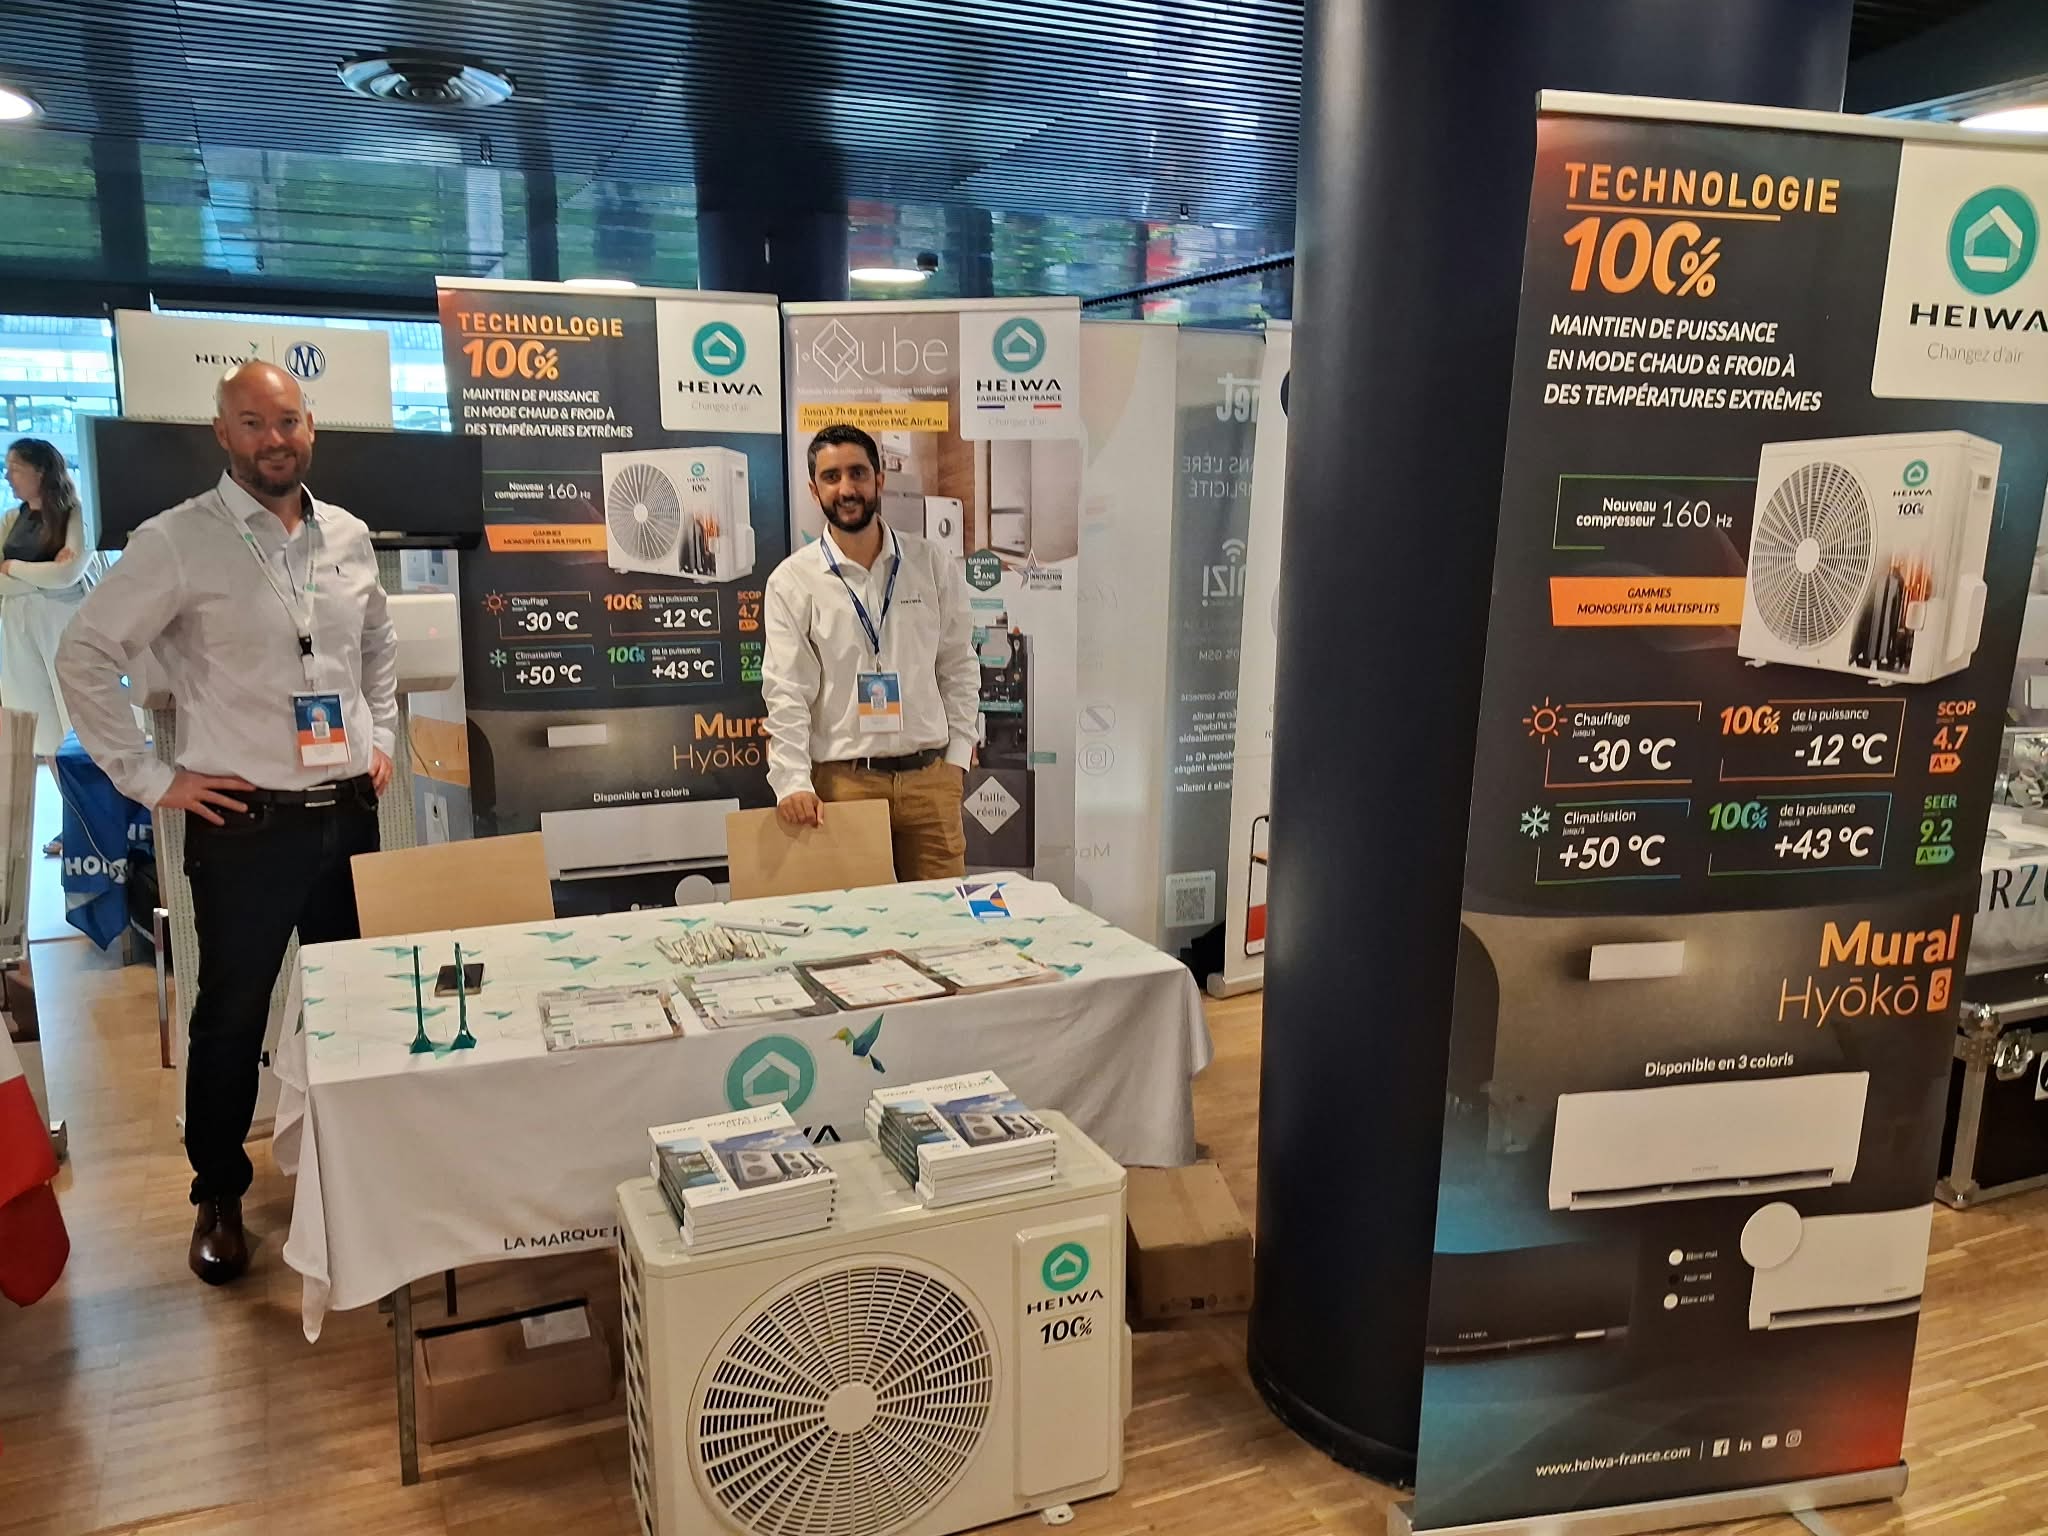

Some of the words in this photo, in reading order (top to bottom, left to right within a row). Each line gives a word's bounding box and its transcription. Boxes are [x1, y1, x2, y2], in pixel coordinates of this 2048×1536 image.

[1564, 162, 1841, 214] TECHNOLOGIE
[457, 312, 624, 337] TECHNOLOGIE
[1910, 303, 2048, 332] HEIWA
[1550, 314, 1645, 339] MAINTIEN
[1649, 318, 1675, 339] DE
[1677, 319, 1779, 343] PUISSANCE
[196, 353, 260, 366] HEIW
[1927, 342, 1990, 365] Changez
[1993, 346, 2025, 363] d'air
[1547, 349, 1574, 370] EN
[1577, 351, 1637, 372] MODE
[1639, 352, 1704, 374] CHAUD
[1706, 355, 1721, 375] &
[1724, 355, 1780, 377] FROID
[1781, 353, 1796, 377] À
[678, 380, 763, 396] HEIWA
[977, 379, 1061, 391] HEIWA
[463, 388, 521, 401] MAINTIEN
[522, 390, 537, 402] DE
[539, 391, 600, 403] PUISSANCE
[1543, 383, 1581, 405] DES
[1585, 383, 1727, 409] TEMPÉRATURES
[1729, 387, 1823, 411] EXTRÊMES
[464, 406, 480, 418] EN
[482, 406, 517, 419] MODE
[518, 407, 559, 420] CHAUD
[560, 408, 569, 420] &
[571, 408, 605, 421] FROID
[804, 407, 833, 417] Jusqu'à
[848, 407, 857, 415] de
[859, 407, 893, 417] gagnées
[867, 418, 889, 426] votre
[891, 418, 908, 426] PAC
[911, 417, 943, 426] Air/Eau
[465, 423, 488, 436] DES
[490, 423, 575, 437] TEMPÉRATURES
[576, 424, 633, 438] EXTRÊMES
[494, 491, 544, 501] compresseur
[509, 482, 544, 491] Nouveau
[547, 483, 578, 500] 160
[1603, 497, 1657, 512] Nouveau
[1662, 500, 1711, 528] 160
[1716, 513, 1733, 528] Hz
[1576, 513, 1655, 529] compresseur
[973, 565, 981, 580] 5
[982, 572, 996, 580] ANS
[649, 595, 657, 603] de
[659, 595, 665, 603] la
[666, 595, 698, 604] puissance
[1627, 588, 1672, 598] GAMMES
[512, 597, 548, 606] Chauffage
[1577, 603, 1644, 615] MONOSPLITS
[1645, 603, 1653, 613] &
[1654, 603, 1720, 614] MULTISPLITS
[654, 608, 686, 628] -12
[690, 608, 713, 627] °C
[738, 604, 760, 618] 4.7
[518, 611, 552, 632] -30
[556, 611, 579, 631] °C
[515, 651, 562, 660] Climatisation
[652, 647, 661, 655] de
[662, 647, 668, 655] la
[669, 647, 701, 656] puissance
[652, 661, 689, 679] +43
[693, 660, 715, 678] °C
[741, 655, 761, 669] 9.2
[516, 665, 555, 685] +50
[560, 664, 582, 684] °C
[1792, 709, 1806, 721] de
[1808, 709, 1817, 721] la
[1819, 708, 1869, 722] puissance
[1937, 700, 1976, 717] SCOP
[694, 712, 769, 740] Mura
[1574, 712, 1631, 727] Chauffage
[1933, 725, 1969, 750] 4.7
[673, 741, 760, 775] Hyōkō
[1578, 738, 1631, 773] -30
[1638, 737, 1676, 771] °C
[1795, 733, 1844, 767] -12
[1851, 733, 1888, 765] °C
[1932, 757, 1956, 769] A++
[594, 790, 640, 802] Disponible
[642, 790, 653, 799] en
[654, 788, 660, 798] 3
[661, 787, 690, 798] coloris
[979, 791, 1006, 803] Taille
[1924, 794, 1957, 809] SEER
[976, 806, 1007, 818] réelle
[1564, 809, 1636, 825] Climatisation
[1780, 804, 1793, 817] de
[1796, 803, 1805, 816] la
[1806, 802, 1856, 818] puissance
[1920, 818, 1953, 844] 9.2
[1774, 828, 1832, 860] +43
[1838, 826, 1874, 858] °C
[1559, 835, 1620, 870] +50
[1628, 834, 1666, 867] °C
[1919, 848, 1949, 862] A+++
[1989, 864, 2048, 910] RZ
[1820, 914, 1961, 969] Mural
[1778, 972, 1920, 1028] Hyōkō
[1932, 976, 1947, 1002] 3
[1645, 1056, 1715, 1078] Disponible
[1718, 1058, 1735, 1071] en
[1738, 1054, 1748, 1069] 3
[1750, 1052, 1794, 1069] coloris
[504, 1237, 525, 1250] LA
[530, 1227, 609, 1248] MARQUE
[1027, 1288, 1103, 1314] HEIWA
[1535, 1446, 1690, 1477] www.heiwa-france.com
